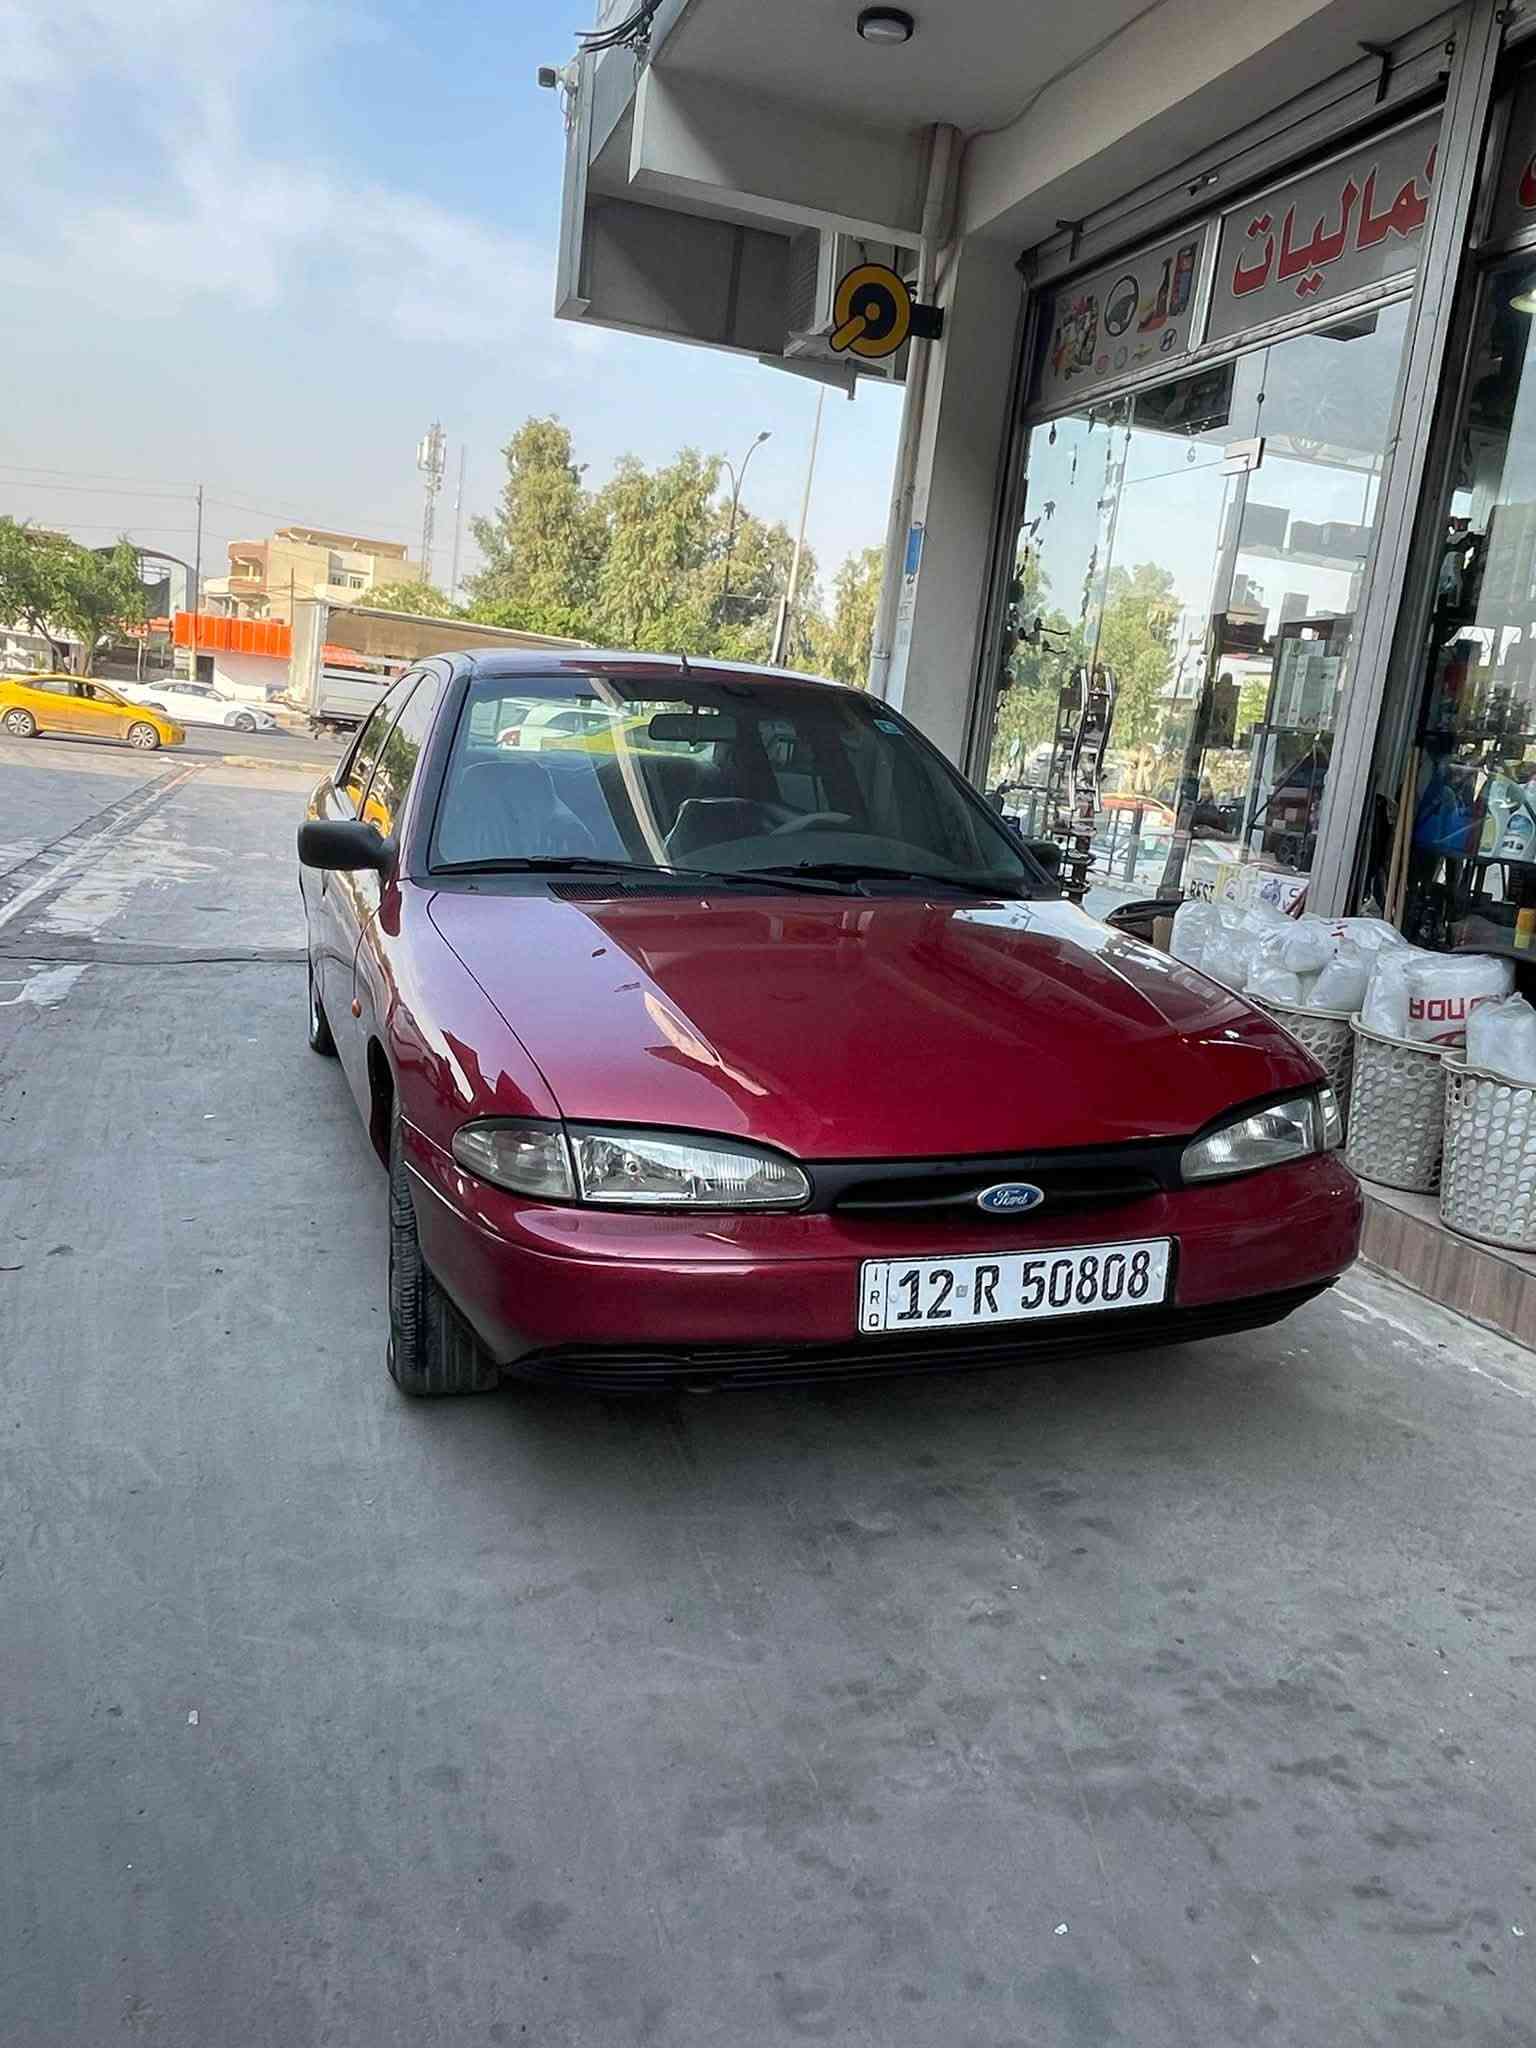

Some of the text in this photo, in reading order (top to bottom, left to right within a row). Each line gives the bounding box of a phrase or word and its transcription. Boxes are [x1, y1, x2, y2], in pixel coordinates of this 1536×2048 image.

[993, 1190, 1028, 1206] Ford
[897, 1250, 1151, 1320] 12 R 50808
